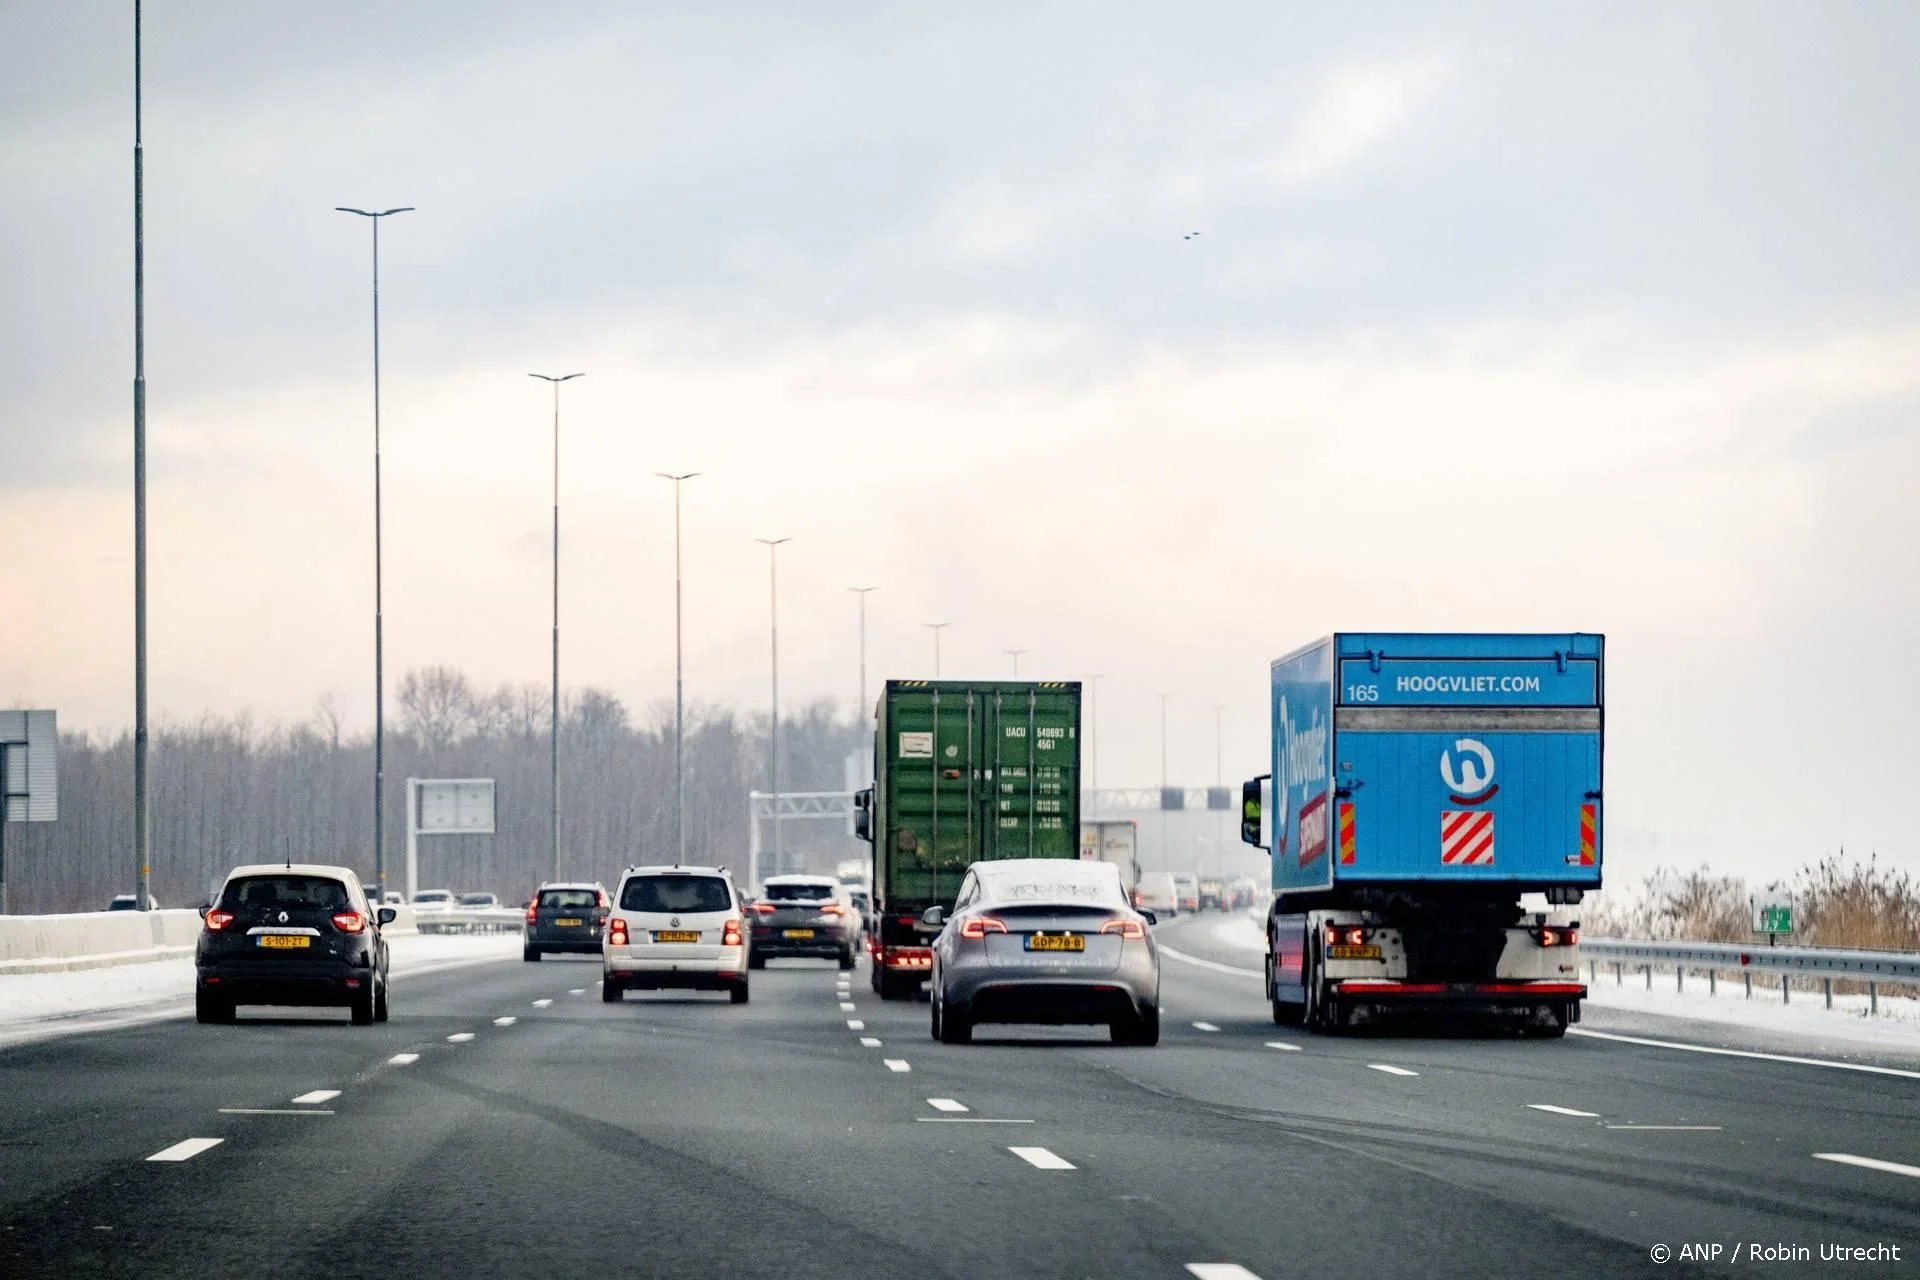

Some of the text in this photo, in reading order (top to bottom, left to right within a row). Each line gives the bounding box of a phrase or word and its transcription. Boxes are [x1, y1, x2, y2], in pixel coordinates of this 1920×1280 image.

[1397, 676, 1540, 692] HOOGVLIET.COM
[1348, 685, 1379, 702] 165
[1005, 727, 1026, 738] UACU
[265, 937, 304, 946] S-101-ZT
[1033, 937, 1081, 948] GDP-78-B
